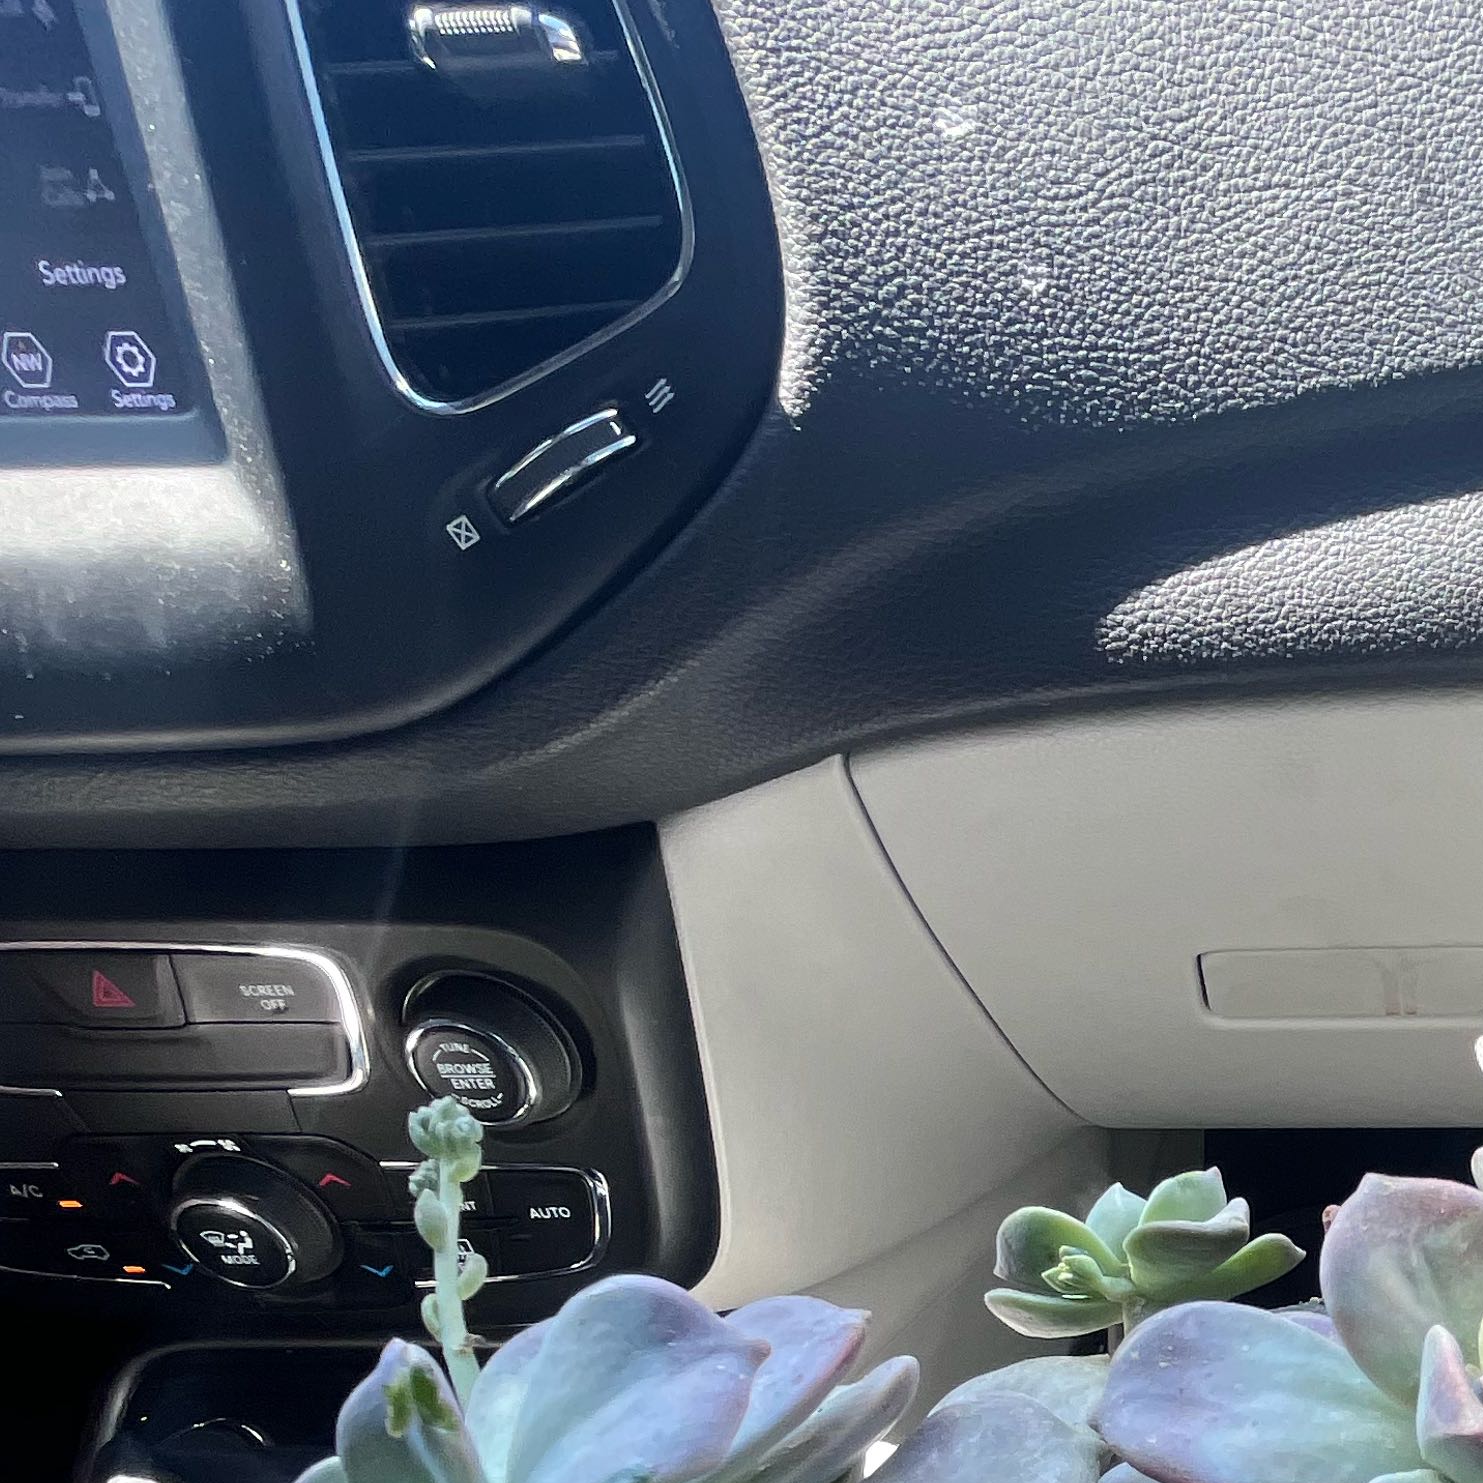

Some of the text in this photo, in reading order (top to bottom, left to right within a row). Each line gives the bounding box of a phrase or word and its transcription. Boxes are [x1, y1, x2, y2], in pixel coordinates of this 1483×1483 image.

[38, 259, 127, 290] Settings
[11, 352, 43, 372] NW
[4, 390, 78, 411] Compass
[111, 388, 176, 411] Settings
[239, 984, 295, 997] SCREEN
[260, 999, 287, 1010] OFF
[439, 1042, 471, 1054] TUNE
[436, 1062, 494, 1075] BROWSE
[450, 1078, 496, 1090] ENTER
[9, 1183, 44, 1199] A/C
[529, 1206, 571, 1220] AUTO
[220, 1254, 261, 1265] MODE
